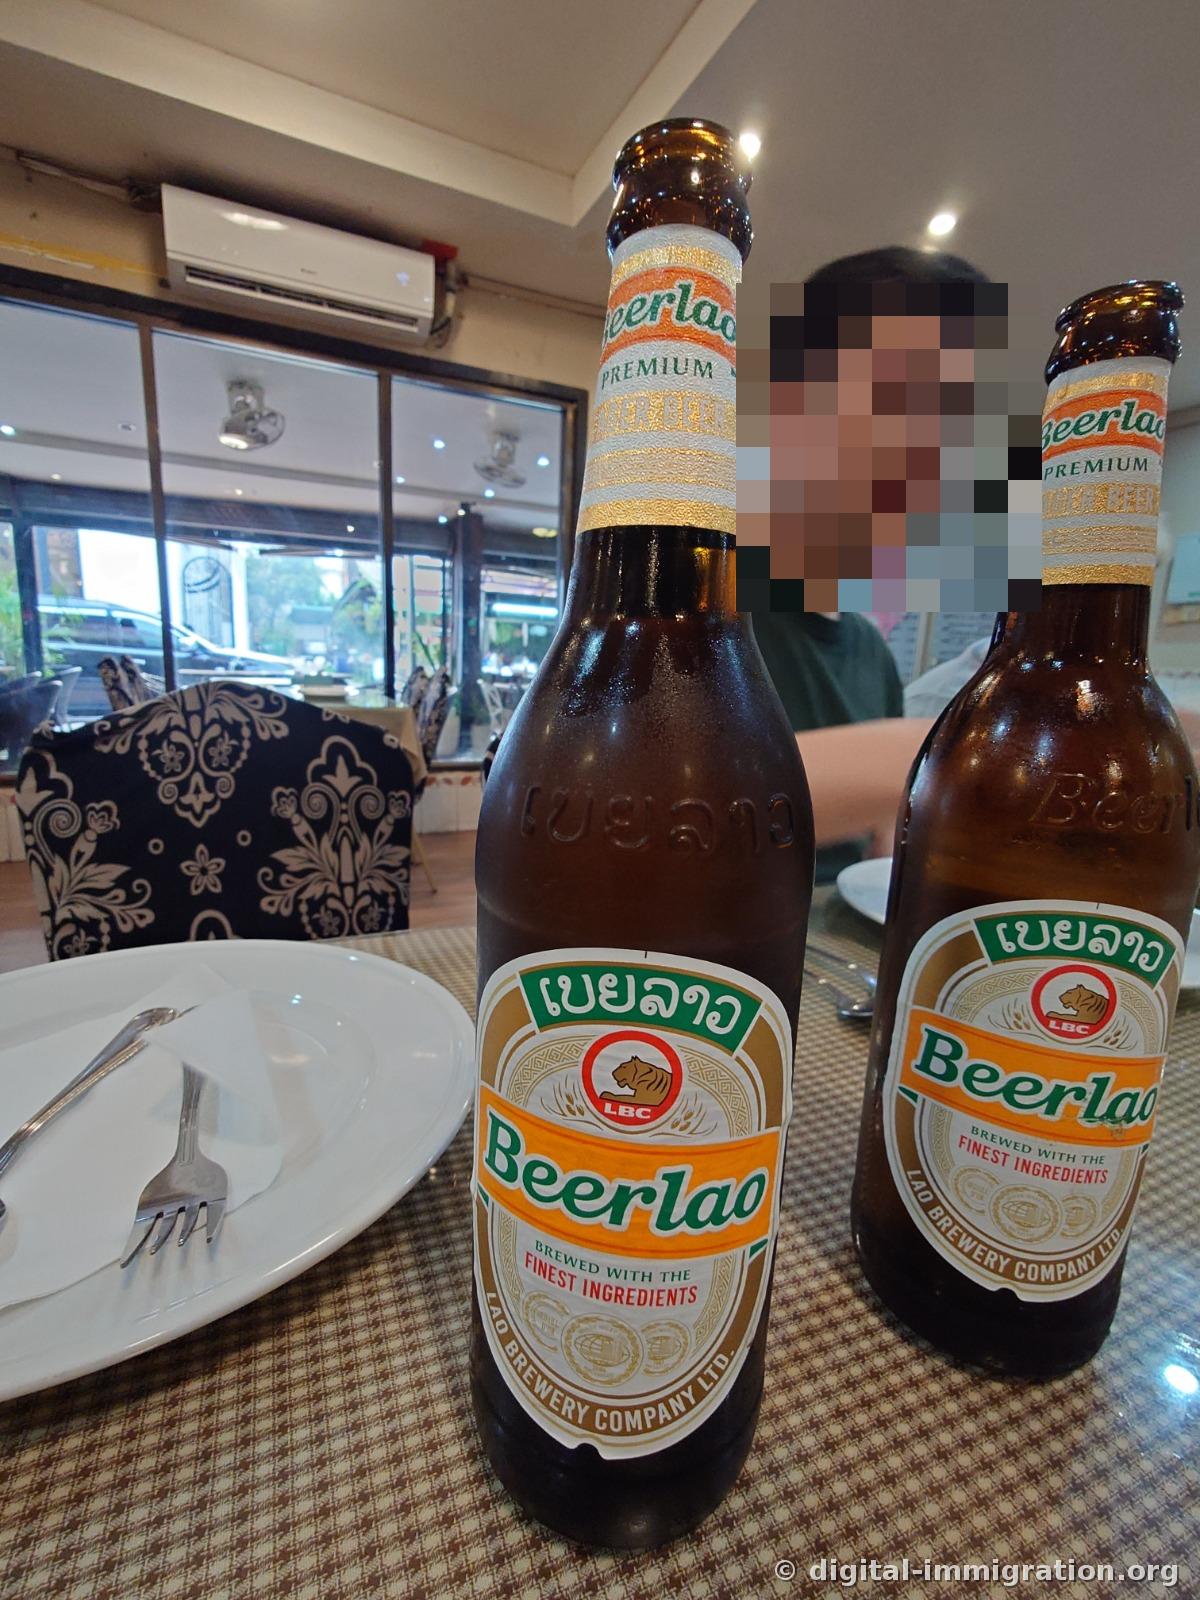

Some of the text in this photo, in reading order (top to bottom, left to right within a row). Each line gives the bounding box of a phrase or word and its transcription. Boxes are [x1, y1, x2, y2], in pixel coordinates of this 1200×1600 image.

[601, 357, 713, 390] PREMIUM
[1044, 457, 1148, 480] PREMIUM
[996, 920, 1165, 973] ເບຍລາວ
[539, 973, 741, 1034] ເບຍລາວ
[1049, 1019, 1089, 1036] LBC
[915, 1026, 1158, 1124] Beerlao
[603, 1102, 652, 1120] LBC
[958, 1135, 1108, 1184] FINEST INGREDIENTS
[970, 1125, 1105, 1165] BREWED WITH THE
[483, 1109, 768, 1233] Beerlao
[906, 1169, 933, 1203] LAO
[928, 1203, 1011, 1274] BREWERY
[1014, 1250, 1097, 1283] COMPANY
[1098, 1227, 1125, 1259] LTD.
[524, 1251, 699, 1308] FINEST INGREDIENTS
[535, 1239, 692, 1283] BREWED WITH THE
[486, 1291, 509, 1335] LAO
[504, 1340, 590, 1425] BREWERY
[594, 1386, 697, 1433] COMPANY
[701, 1348, 735, 1393] LTD.
